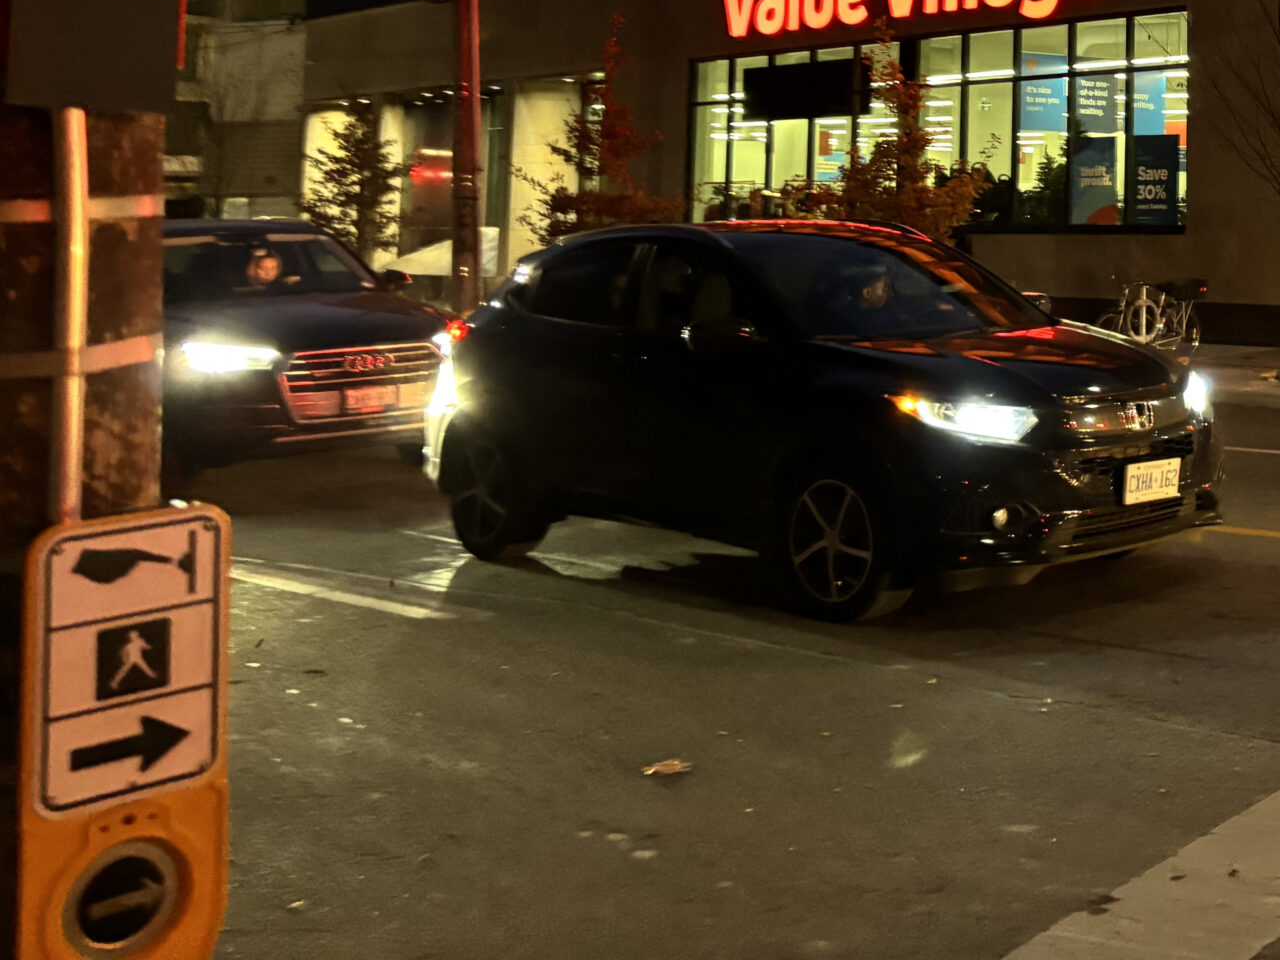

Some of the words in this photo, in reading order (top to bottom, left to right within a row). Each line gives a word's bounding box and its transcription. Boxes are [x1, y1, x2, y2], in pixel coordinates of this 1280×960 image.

[1080, 79, 1095, 87] Your
[1047, 97, 1060, 105] you
[1137, 166, 1168, 181] Save
[1136, 184, 1166, 200] 30%
